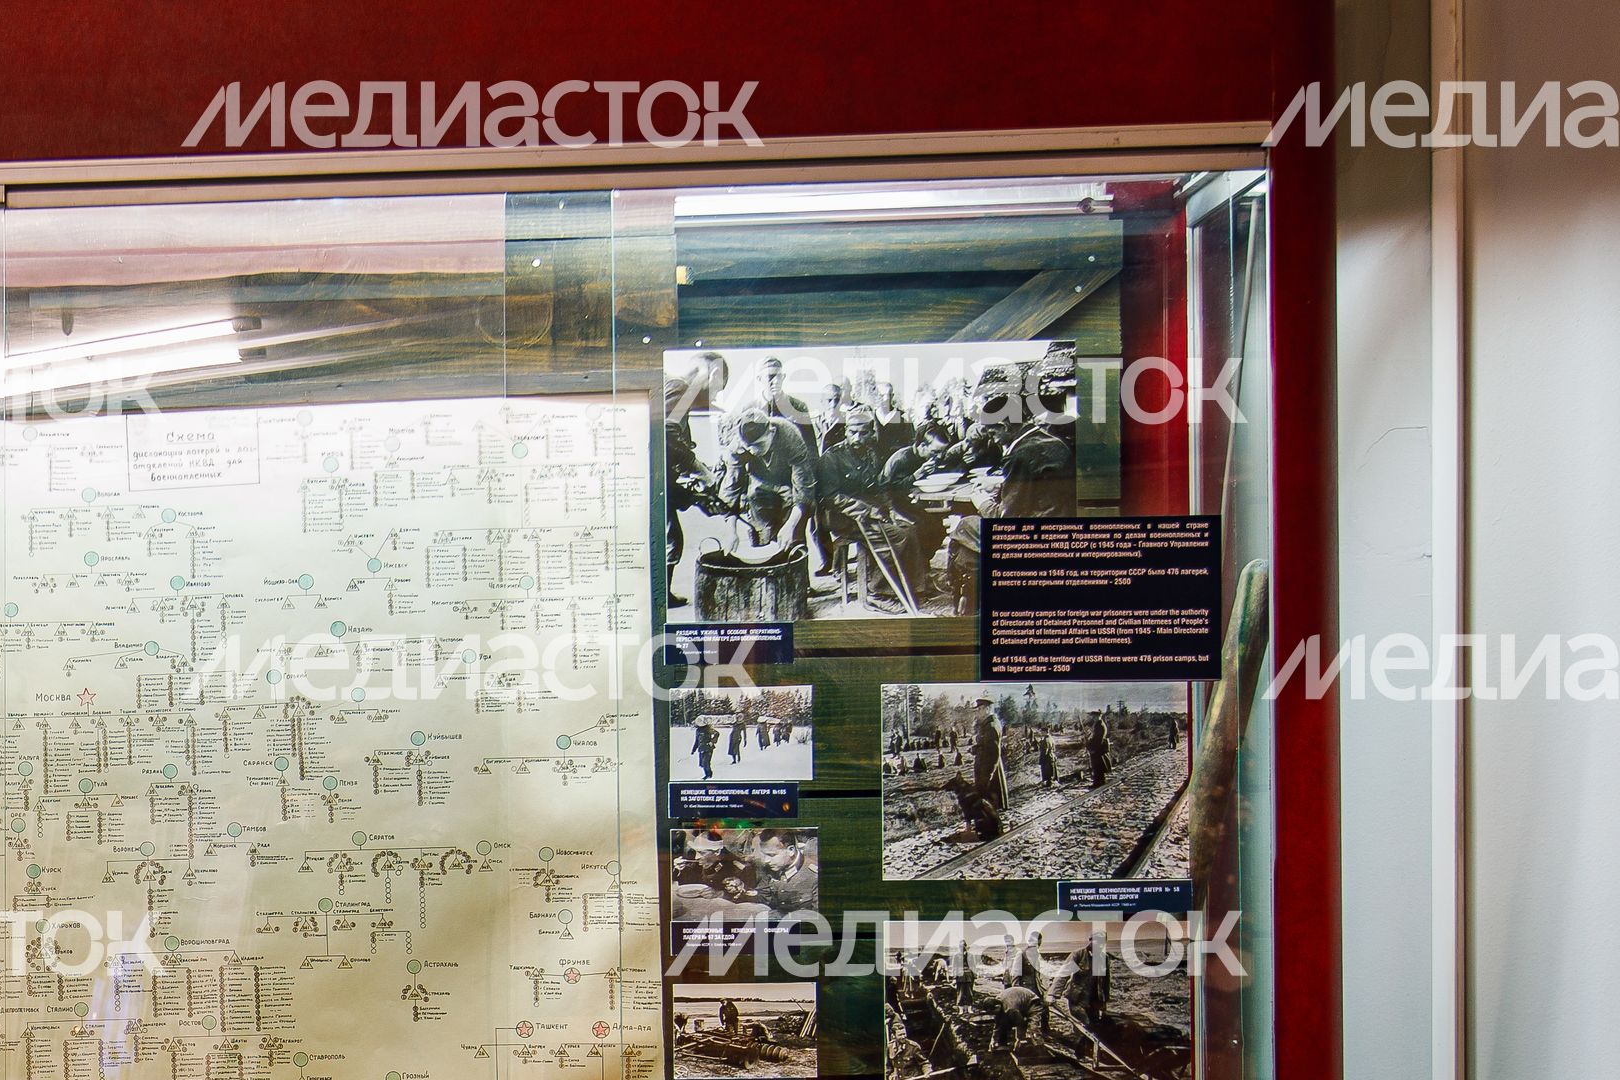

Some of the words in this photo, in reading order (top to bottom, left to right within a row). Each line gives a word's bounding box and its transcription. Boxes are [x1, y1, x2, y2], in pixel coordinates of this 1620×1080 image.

[992, 524, 1016, 532] Лагеря
[1089, 523, 1140, 531] военнопленных
[1157, 522, 1179, 530] нашей
[1185, 522, 1208, 530] стране
[1041, 534, 1068, 542] ведении
[1071, 532, 1110, 542] Управления
[1124, 532, 1146, 542] делам
[991, 570, 1001, 578] По
[1090, 569, 1127, 578] территории
[1128, 568, 1146, 576] СССР
[1147, 568, 1165, 576] было
[992, 610, 998, 618] In
[1057, 609, 1066, 617] for
[1067, 610, 1089, 618] foreign
[1149, 609, 1168, 617] under
[1180, 608, 1208, 620] authority
[992, 656, 1001, 664] As
[1001, 656, 1009, 664] of
[1049, 656, 1076, 664] territory
[1076, 655, 1083, 663] of
[1084, 655, 1103, 663] USSR
[1103, 655, 1120, 663] there
[1152, 655, 1173, 663] prison
[1198, 654, 1209, 662] but
